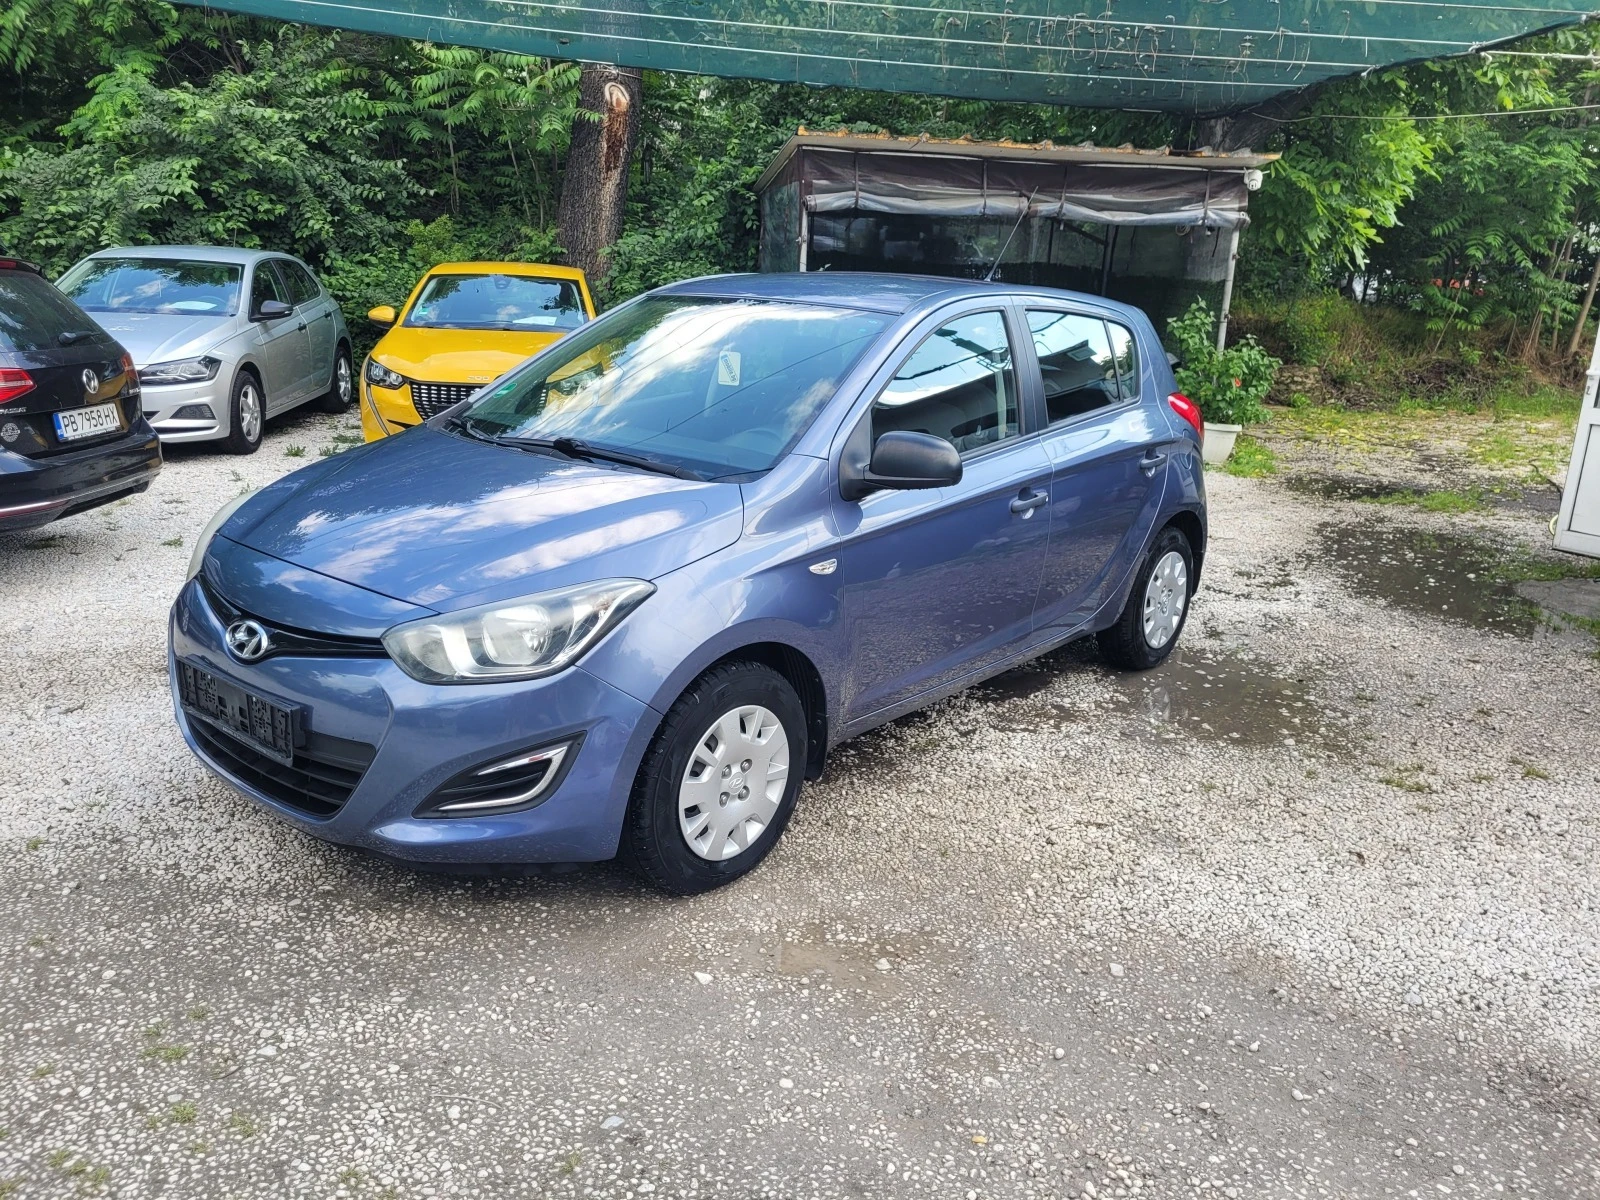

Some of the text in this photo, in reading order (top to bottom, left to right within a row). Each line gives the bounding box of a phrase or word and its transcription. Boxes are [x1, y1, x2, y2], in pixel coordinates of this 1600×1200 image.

[62, 413, 78, 433] PB
[79, 411, 104, 430] 7958
[104, 407, 118, 425] HX
